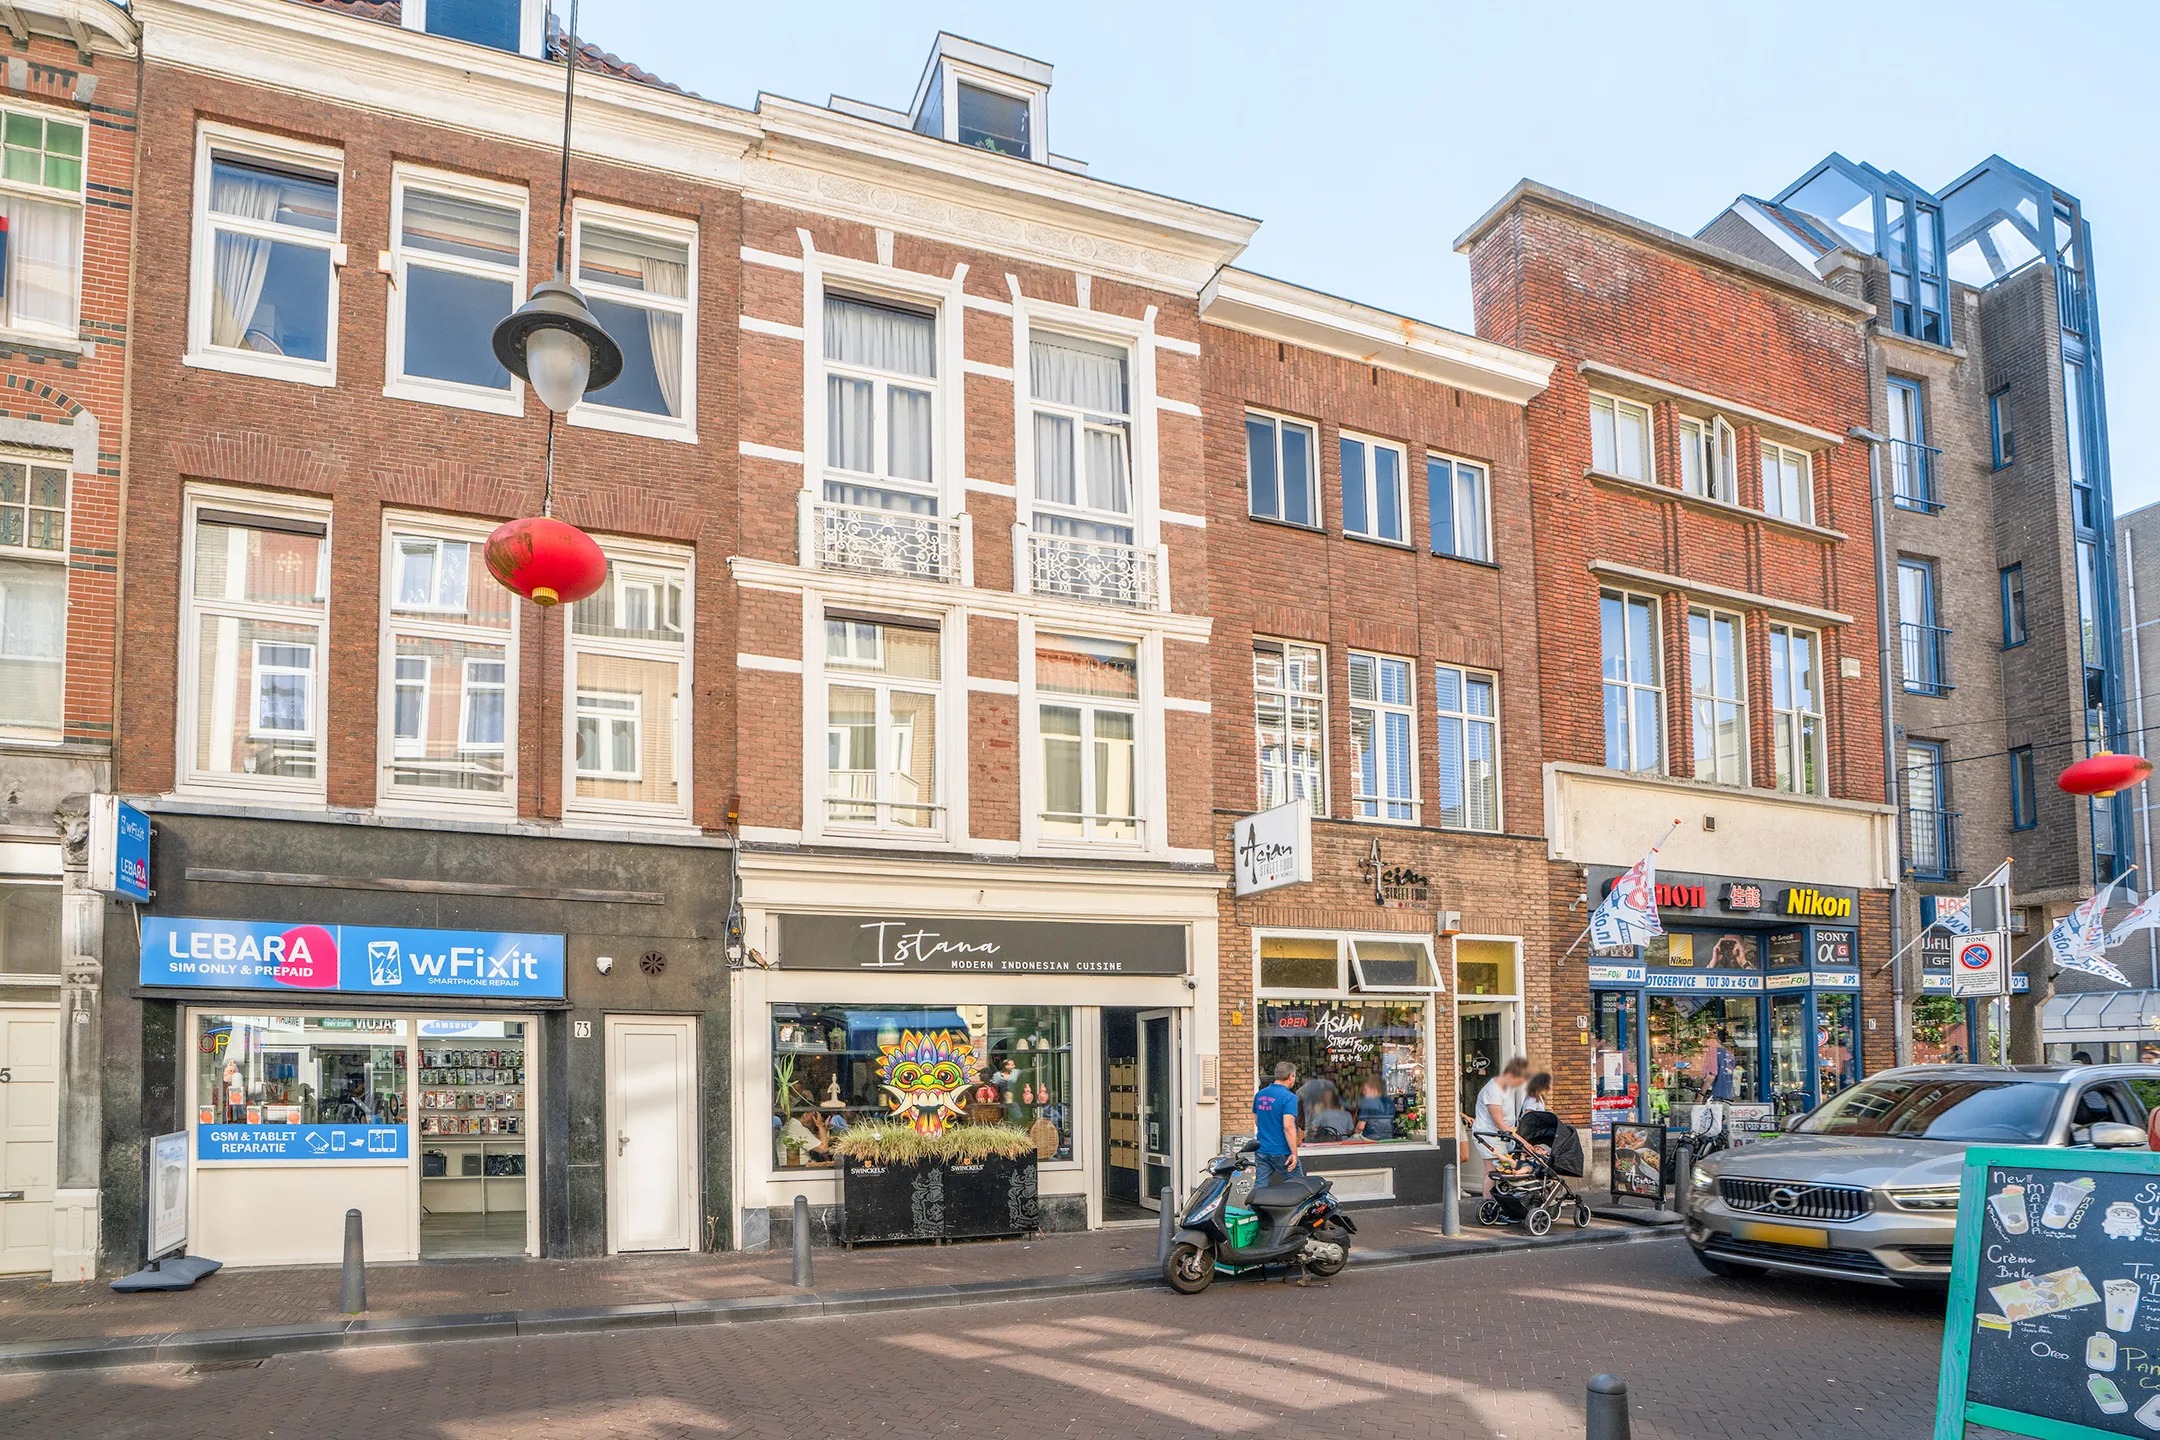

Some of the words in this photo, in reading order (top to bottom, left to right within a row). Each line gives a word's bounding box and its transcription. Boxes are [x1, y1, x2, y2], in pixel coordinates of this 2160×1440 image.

[120, 857, 147, 882] LEBARA
[1787, 887, 1851, 917] Nikon
[1816, 932, 1849, 942] SONY
[1965, 936, 1987, 944] ZONE
[169, 931, 314, 964] LEBARA
[859, 920, 1001, 968] Istana
[408, 941, 538, 980] wFixit
[951, 960, 994, 970] MODERN
[1001, 960, 1069, 970] INDONESIAN
[1076, 961, 1123, 971] CUISINE
[1669, 955, 1693, 967] Nikon
[1932, 956, 1951, 966] GF
[169, 962, 196, 973] SIM
[198, 963, 237, 974] ONLY
[240, 965, 252, 975] &
[254, 965, 314, 977] PREPAID
[1626, 969, 1641, 980] DIA
[428, 977, 487, 986] SMARTPHONE
[489, 979, 520, 987] REPAIR
[1646, 975, 1696, 988] OTOSERVICE
[1705, 976, 1720, 988] TOT
[1720, 976, 1730, 988] 30
[1731, 979, 1736, 988] x
[1737, 977, 1747, 988] 45
[1748, 978, 1759, 988] CM
[1843, 975, 1856, 984] APS
[2012, 977, 2026, 988] O'S
[429, 1021, 474, 1030] SAMSUNG
[1278, 1017, 1309, 1029] OPEN
[576, 1022, 590, 1037] 73
[1352, 1039, 1375, 1054] FOOD
[210, 1132, 239, 1141] GSM
[240, 1132, 251, 1141] &
[252, 1132, 297, 1141] TABLET
[221, 1143, 287, 1153] REPARATIE
[1987, 1244, 2036, 1264] Crème
[2030, 1341, 2070, 1360] Oreo
